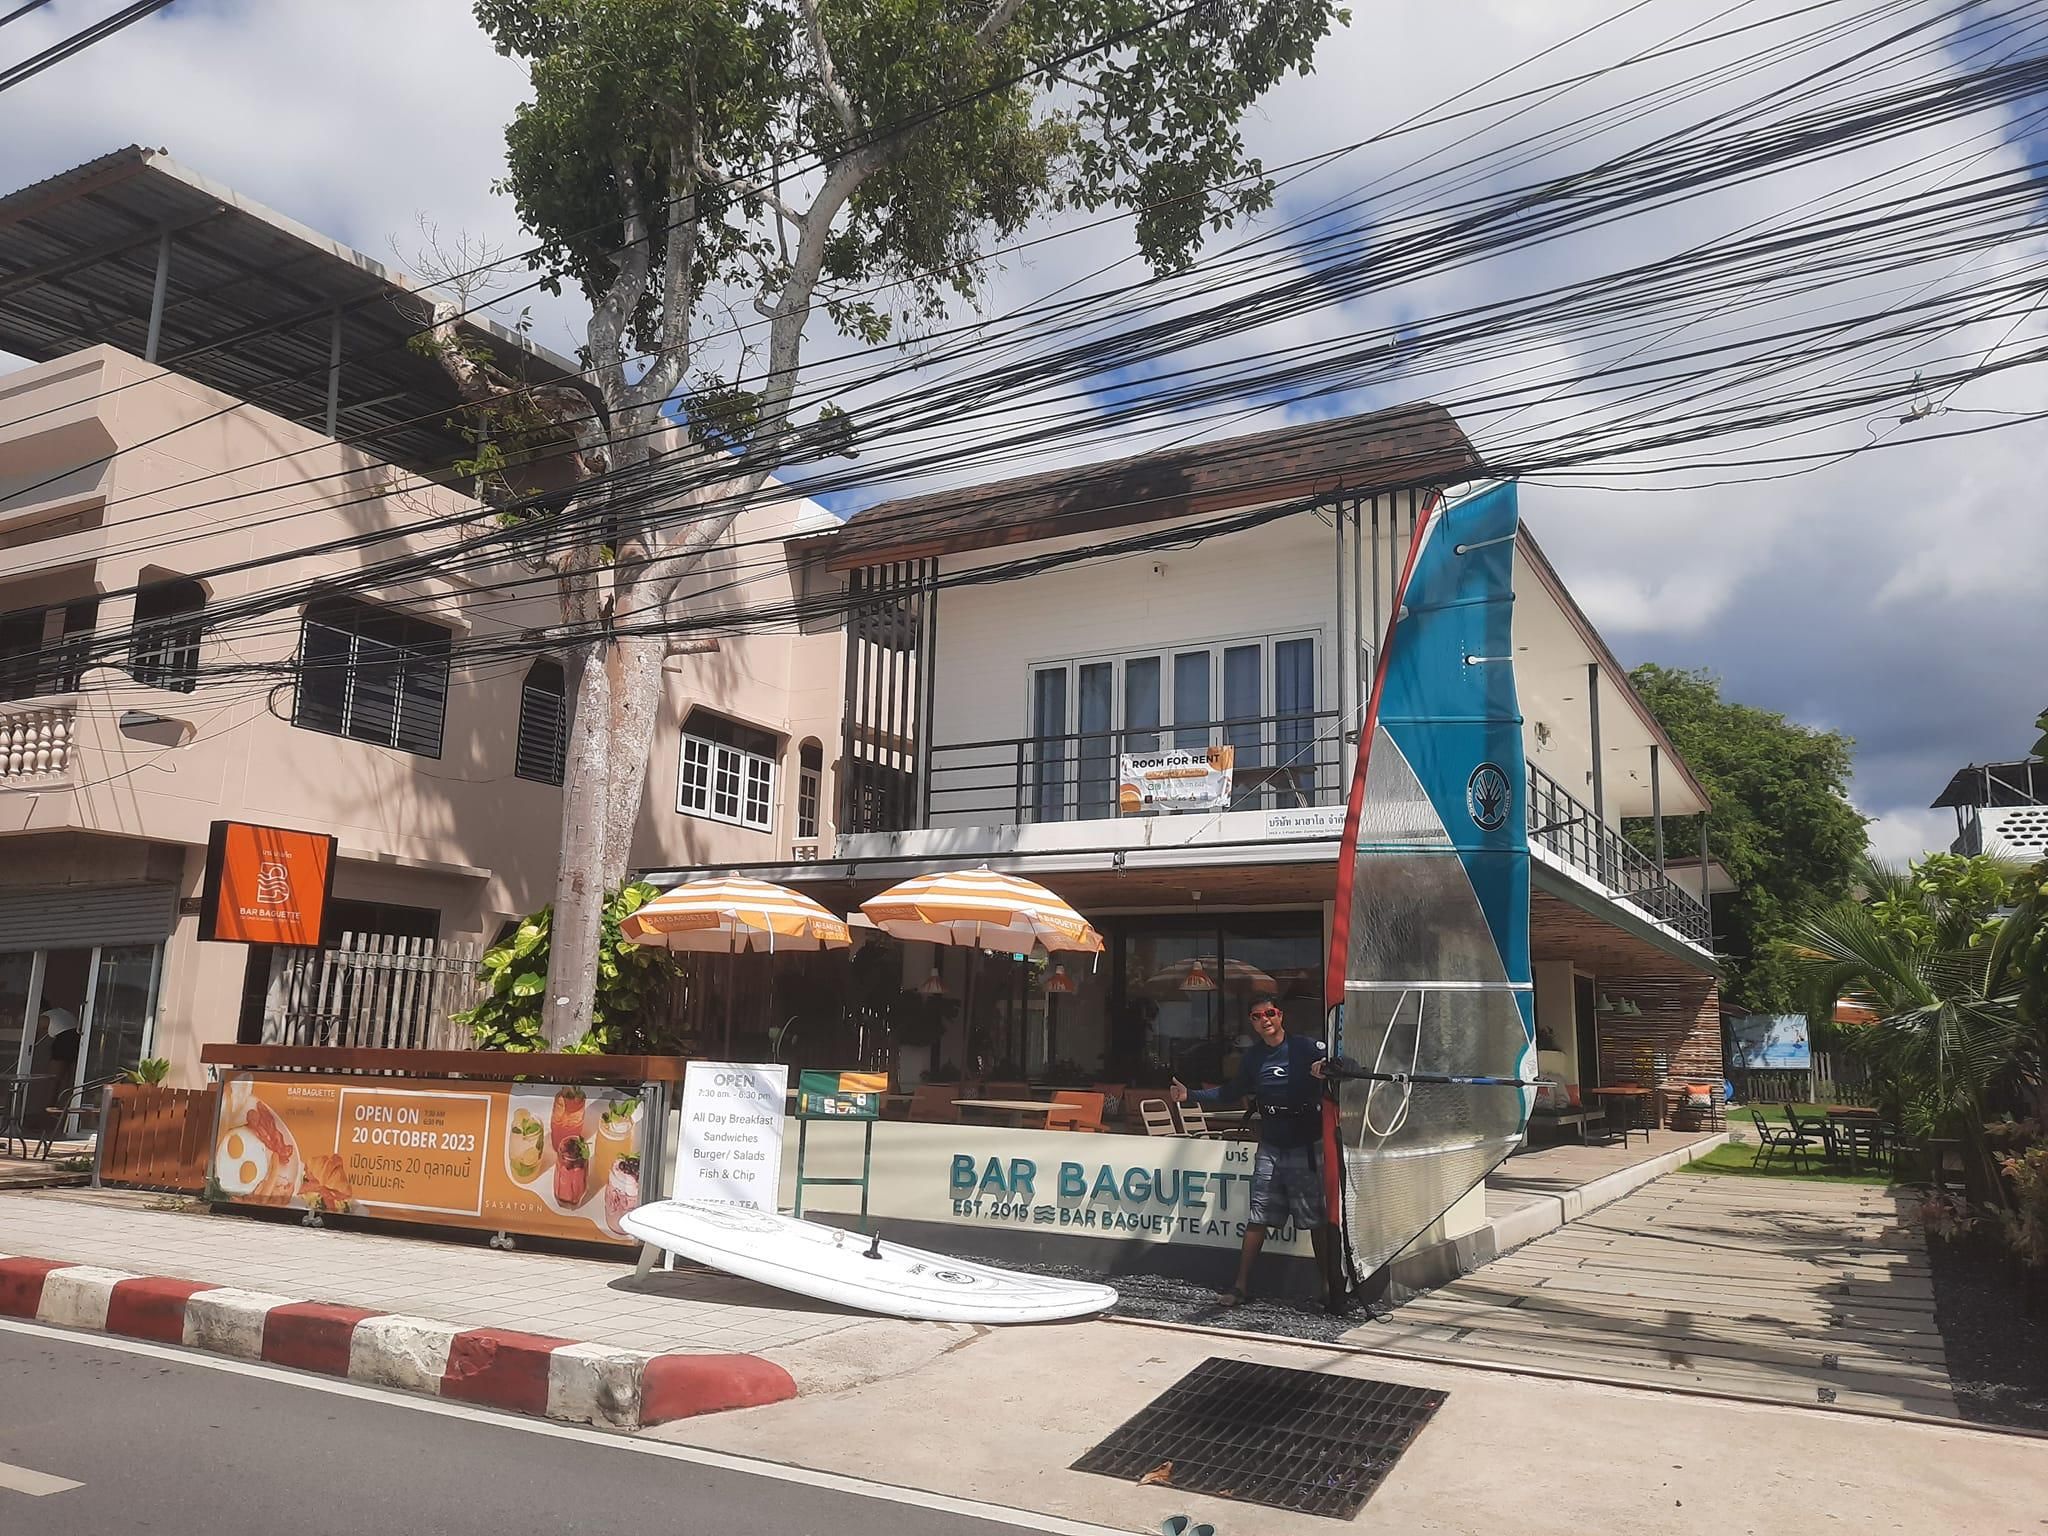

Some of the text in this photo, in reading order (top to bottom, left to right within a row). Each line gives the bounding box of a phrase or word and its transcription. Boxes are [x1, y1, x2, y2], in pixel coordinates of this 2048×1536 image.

[1132, 754, 1220, 769] ROOM FOR RENT
[1328, 812, 1346, 825] จำกั
[240, 907, 301, 919] BAR BAGUETTE
[713, 1073, 755, 1088] OPEN
[287, 1087, 302, 1096] BAR
[698, 1088, 715, 1098] 7:30
[355, 1104, 419, 1125] OPEN ON
[693, 1112, 773, 1126] All Day Breakfast
[351, 1127, 475, 1152] 20 OCTOBER 2023
[703, 1131, 759, 1143] Sandwiches
[693, 1148, 765, 1161] Burger/ Salads
[1225, 1147, 1249, 1162] บาร์
[350, 1153, 472, 1179] เปิดบริการ 20 ตุลาคมนี้
[699, 1168, 756, 1182] Fish & Chip
[952, 1154, 1256, 1211] BAR BAGUETT
[485, 1200, 543, 1212] SASATORN
[739, 1200, 760, 1211] TEA
[1059, 1207, 1097, 1226] BAR
[1101, 1211, 1200, 1234] BAGUETTE
[1206, 1220, 1231, 1236] AT
[1235, 1222, 1297, 1242] SMUI
